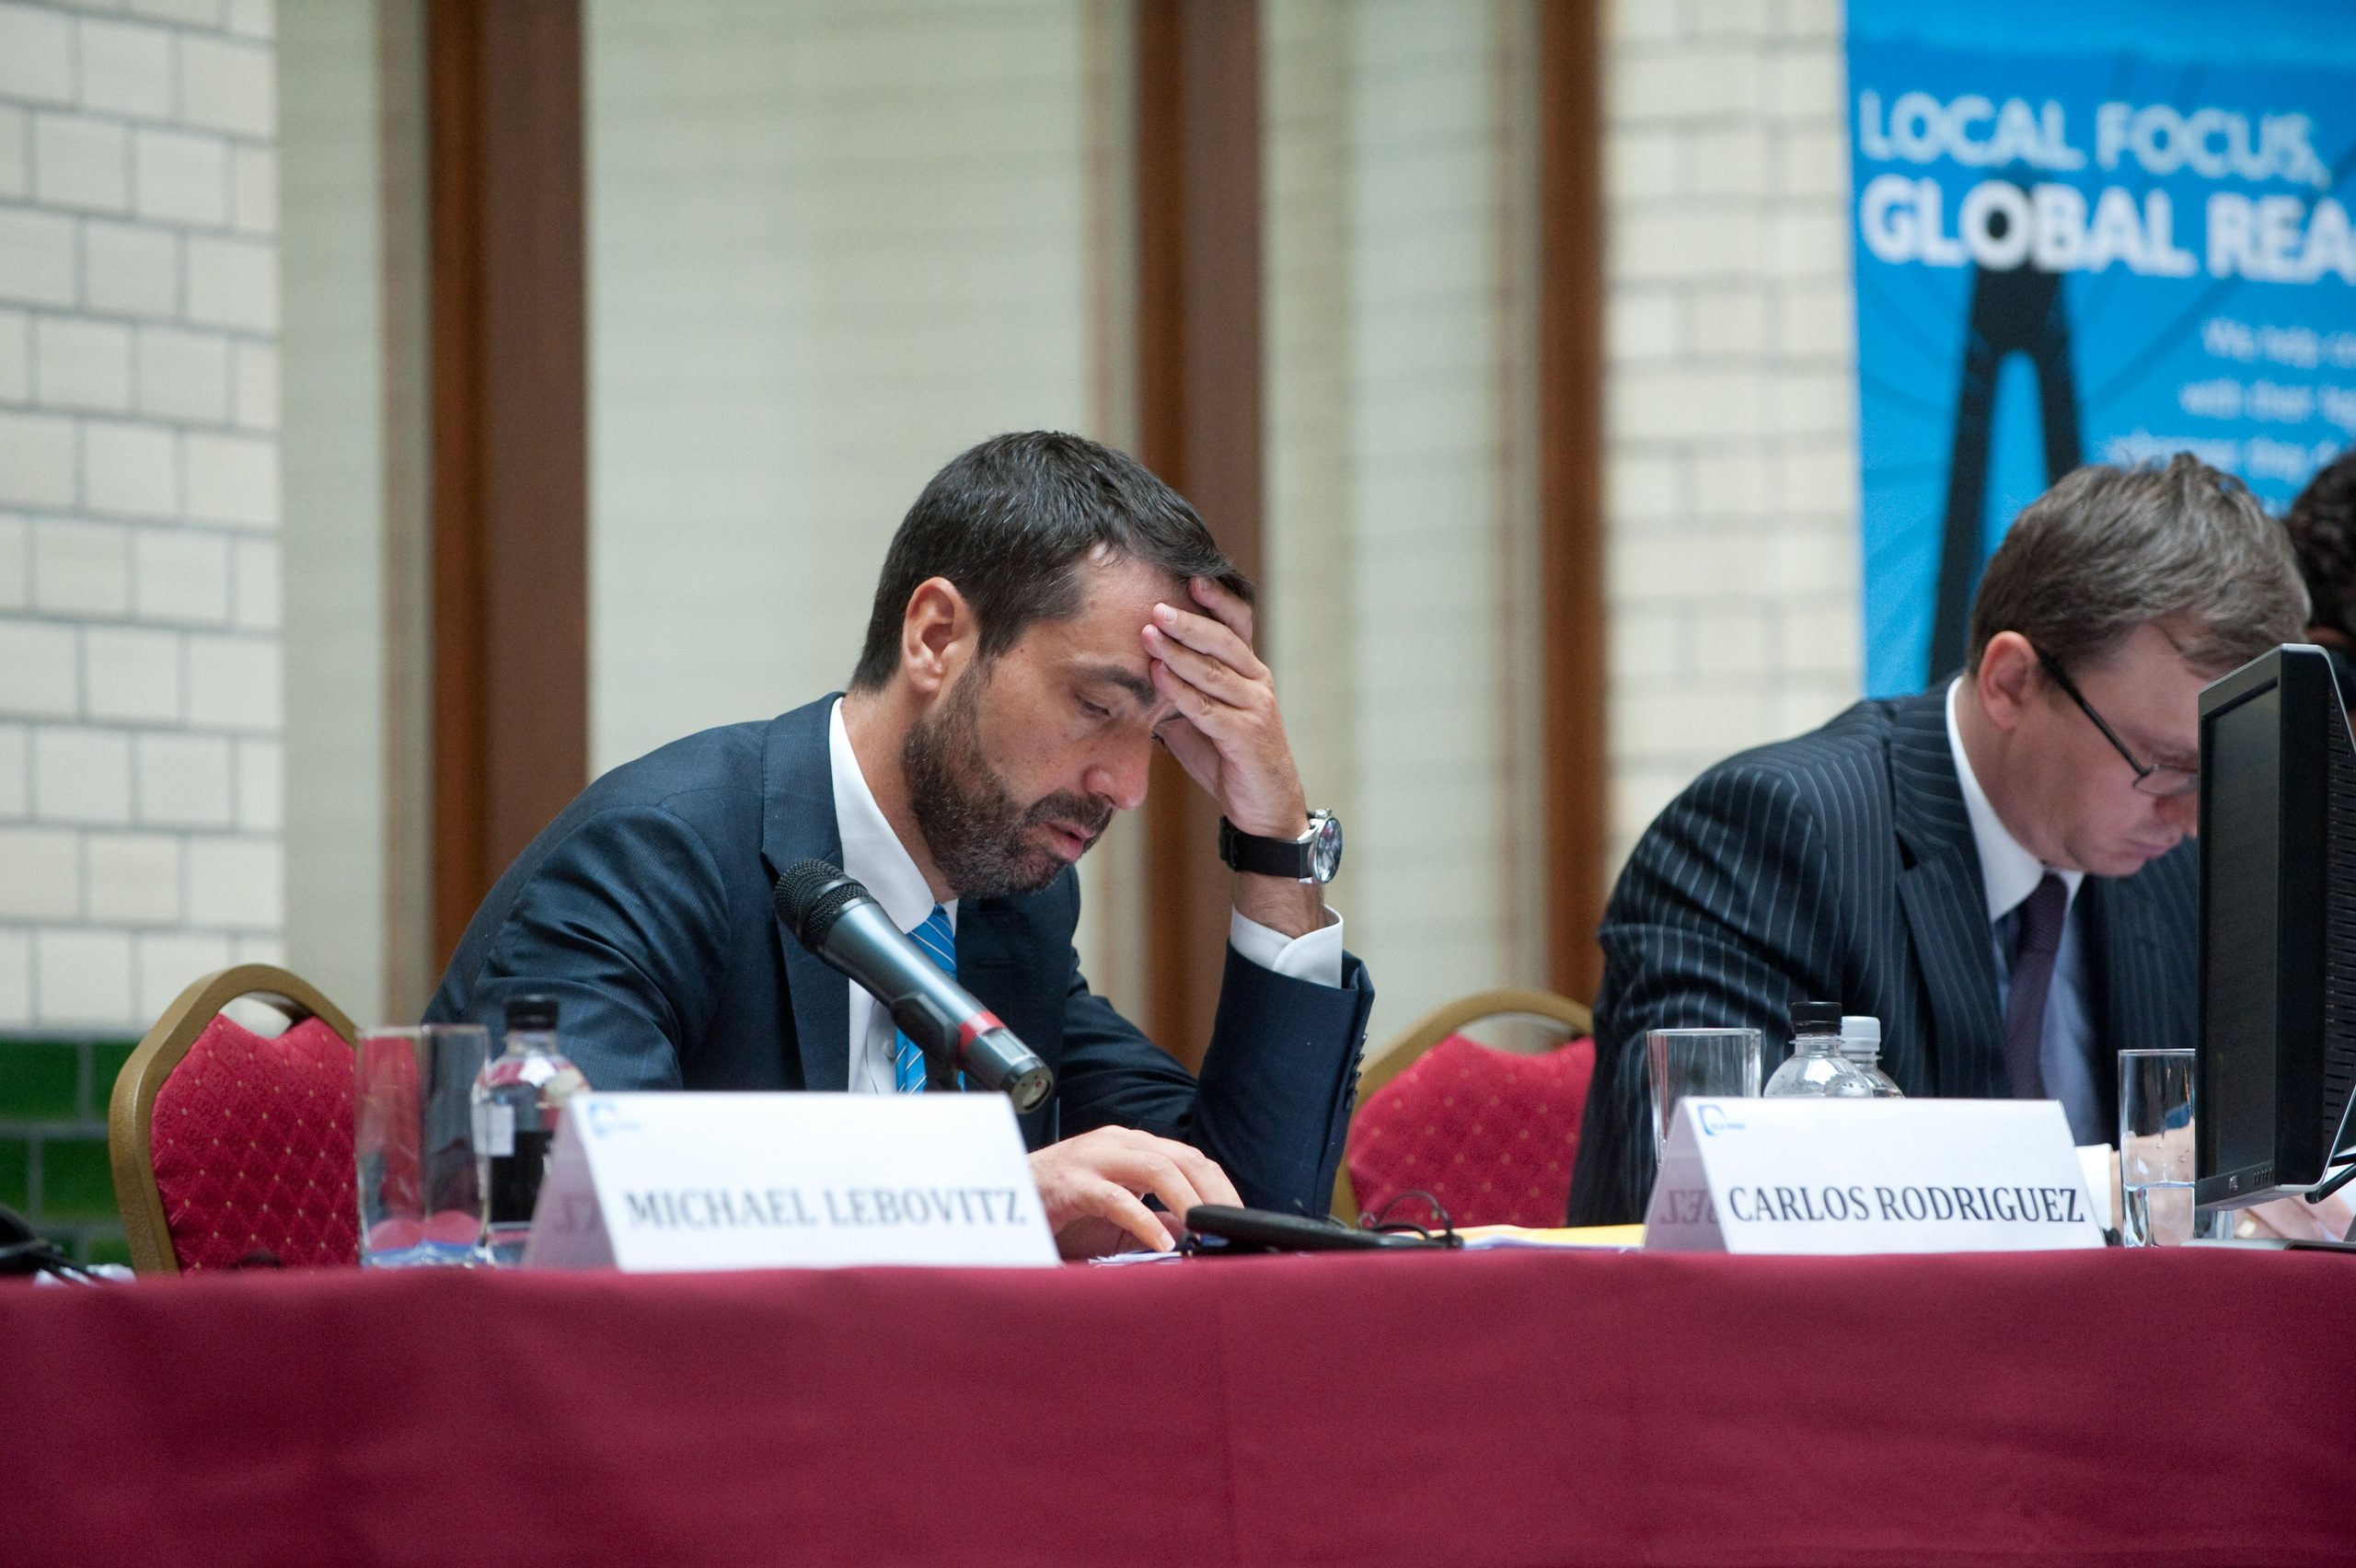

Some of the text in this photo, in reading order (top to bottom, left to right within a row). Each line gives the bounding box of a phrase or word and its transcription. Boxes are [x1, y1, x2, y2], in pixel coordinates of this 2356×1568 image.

[1860, 90, 2084, 171] LOCAL
[1861, 175, 2197, 277] GLOBAL
[625, 1189, 817, 1229] MICHAEL
[828, 1189, 1027, 1227] LEBOVITZ
[1730, 1185, 1869, 1223] CARLOS
[1875, 1187, 2085, 1223] RODRIGUEZ
